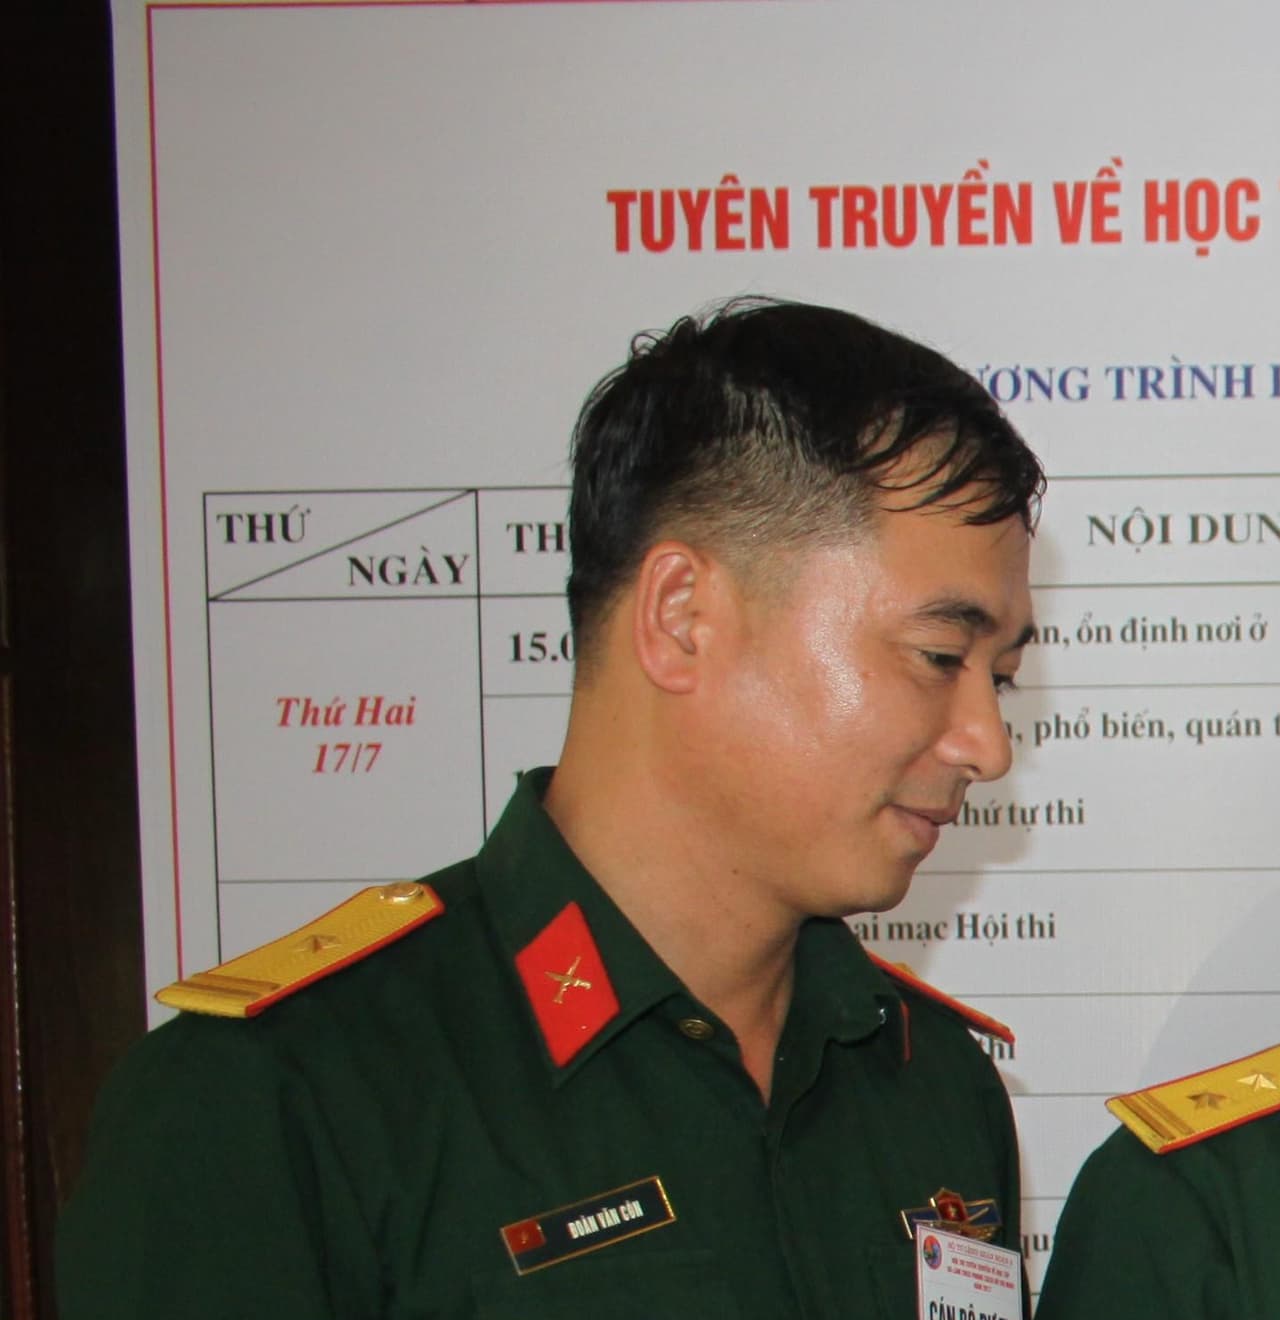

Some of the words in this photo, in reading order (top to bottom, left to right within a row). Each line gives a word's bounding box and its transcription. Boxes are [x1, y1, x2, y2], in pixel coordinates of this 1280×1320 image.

[606, 173, 790, 253] TUYÊN
[808, 158, 1033, 249] TRUYỀN
[1052, 156, 1125, 244] VỀ
[1143, 178, 1260, 257] HỌC
[977, 363, 1090, 402] ƠNG
[1105, 355, 1255, 401] TRÌNH
[216, 503, 312, 543] THỨ
[507, 522, 565, 553] TH
[1087, 506, 1172, 553] NỘI
[348, 546, 471, 586] NGÀY
[509, 632, 575, 662] 15.0
[1077, 611, 1112, 645] ổn
[1120, 616, 1187, 652] định
[1196, 617, 1242, 644] nơi
[1249, 611, 1268, 644] ở
[277, 696, 348, 727] Thứ
[354, 696, 416, 727] Hai
[1034, 706, 1090, 747] phổ
[1102, 711, 1175, 743] biến,
[1185, 712, 1261, 747] quán
[313, 742, 383, 773] 17/7
[1008, 802, 1040, 833] tự
[1046, 799, 1084, 825] thi
[855, 915, 879, 941] ai
[887, 920, 948, 947] mạc
[956, 912, 1008, 946] Hội
[1017, 912, 1056, 939] thi
